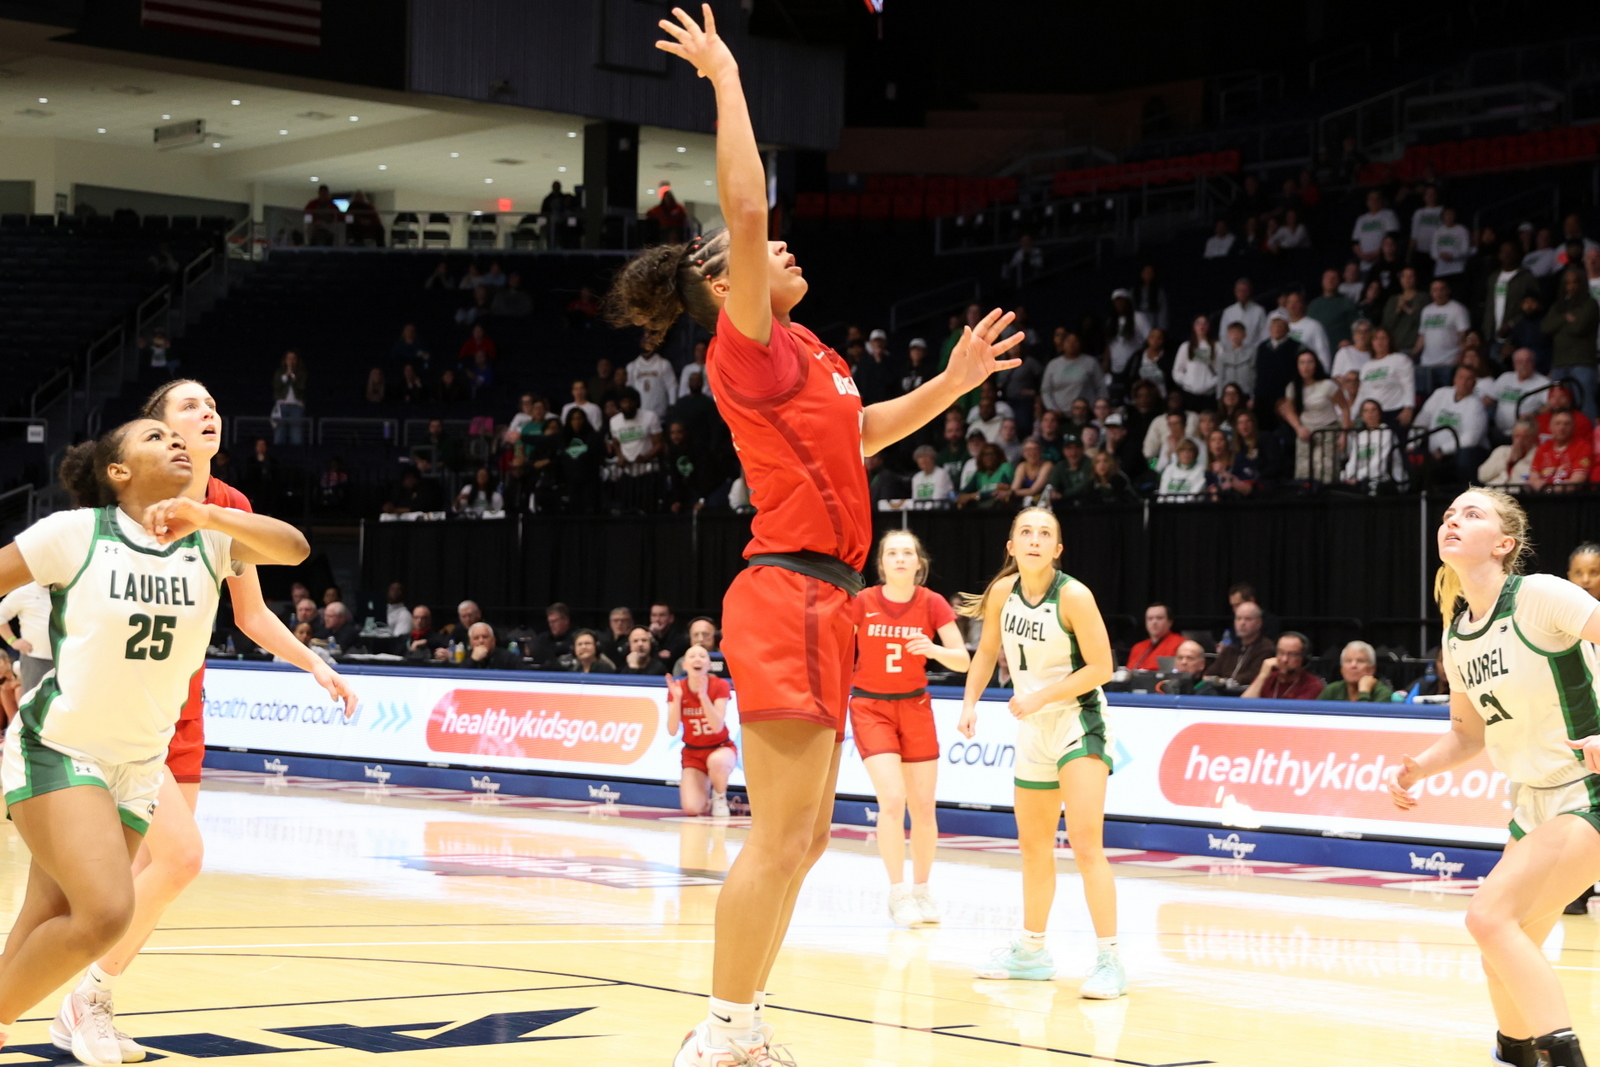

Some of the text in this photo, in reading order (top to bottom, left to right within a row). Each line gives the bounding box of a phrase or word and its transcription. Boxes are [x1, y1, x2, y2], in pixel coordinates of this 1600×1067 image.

[110, 569, 195, 606] LAUREL
[125, 613, 177, 661] 25
[1004, 613, 1046, 642] LAUREL
[885, 642, 903, 673] 2
[1018, 643, 1028, 671] 1
[1457, 647, 1509, 690] LAUREL
[250, 701, 299, 722] action
[1479, 690, 1514, 726] 21
[440, 706, 644, 752] healthykidsgo.org
